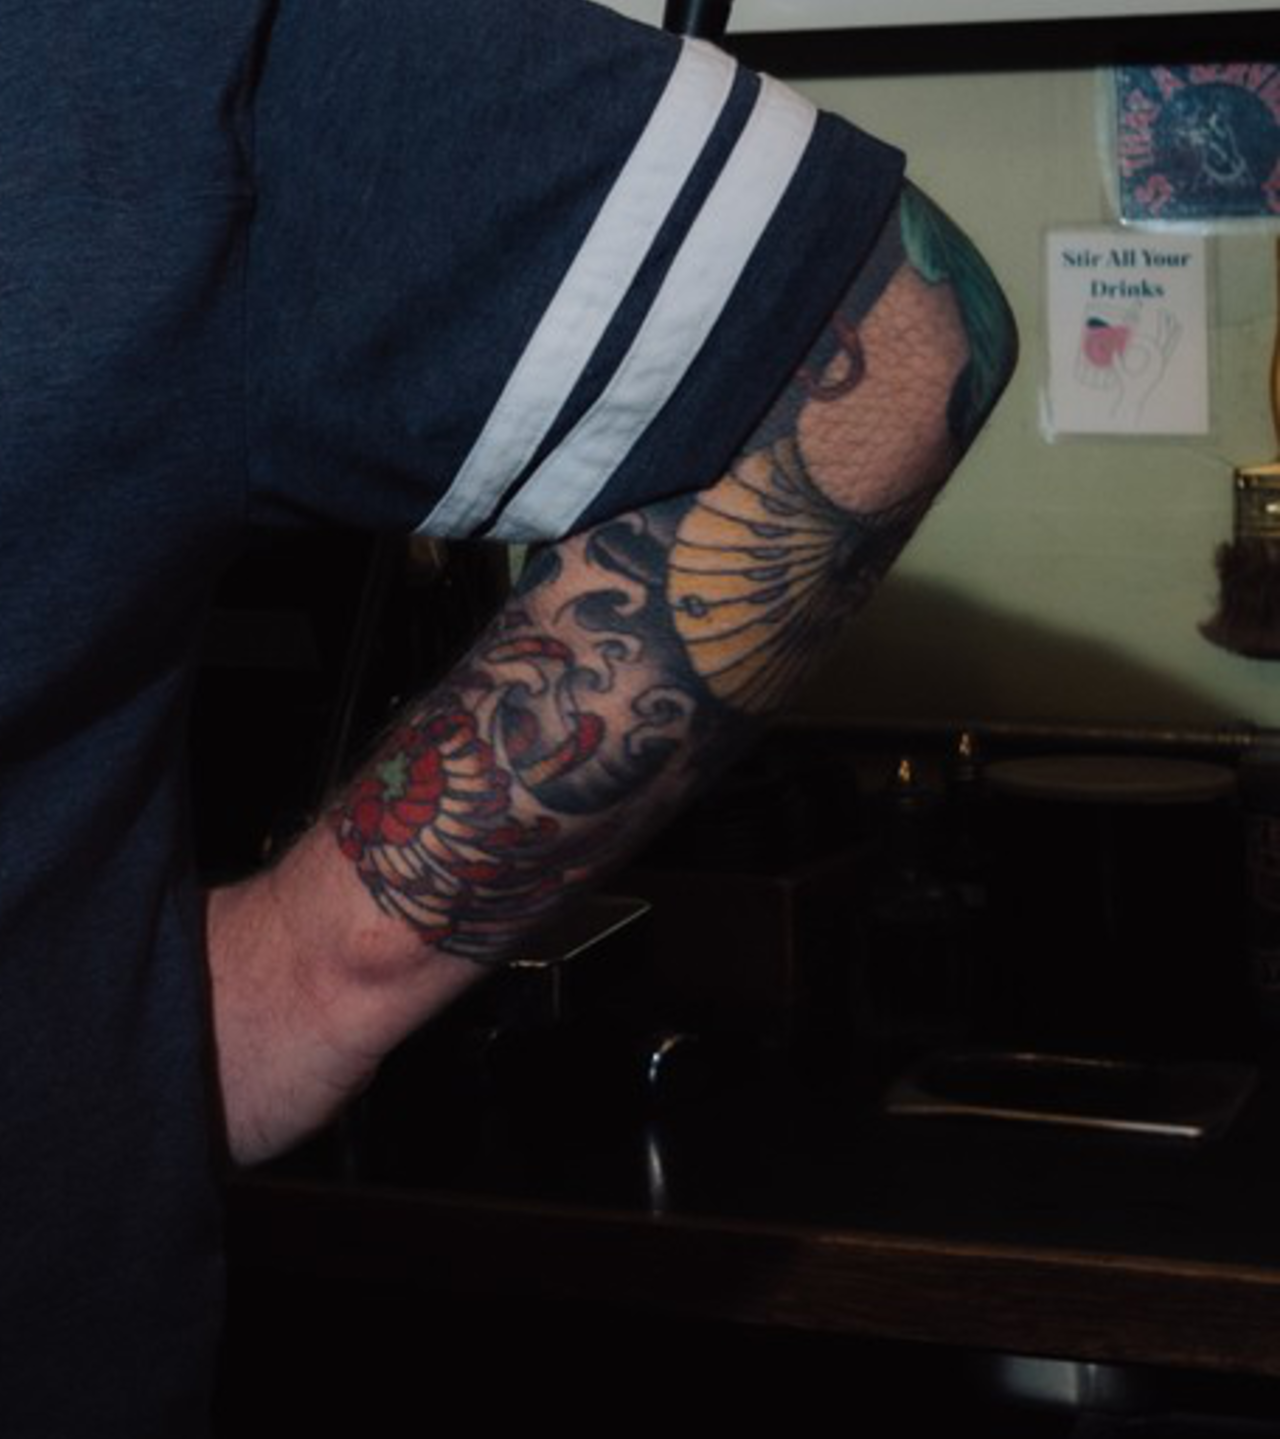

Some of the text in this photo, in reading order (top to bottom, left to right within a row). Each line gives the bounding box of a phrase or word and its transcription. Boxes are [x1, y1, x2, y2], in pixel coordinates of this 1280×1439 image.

[1062, 250, 1190, 269] Stir All Your
[1090, 280, 1165, 299] Drinks
